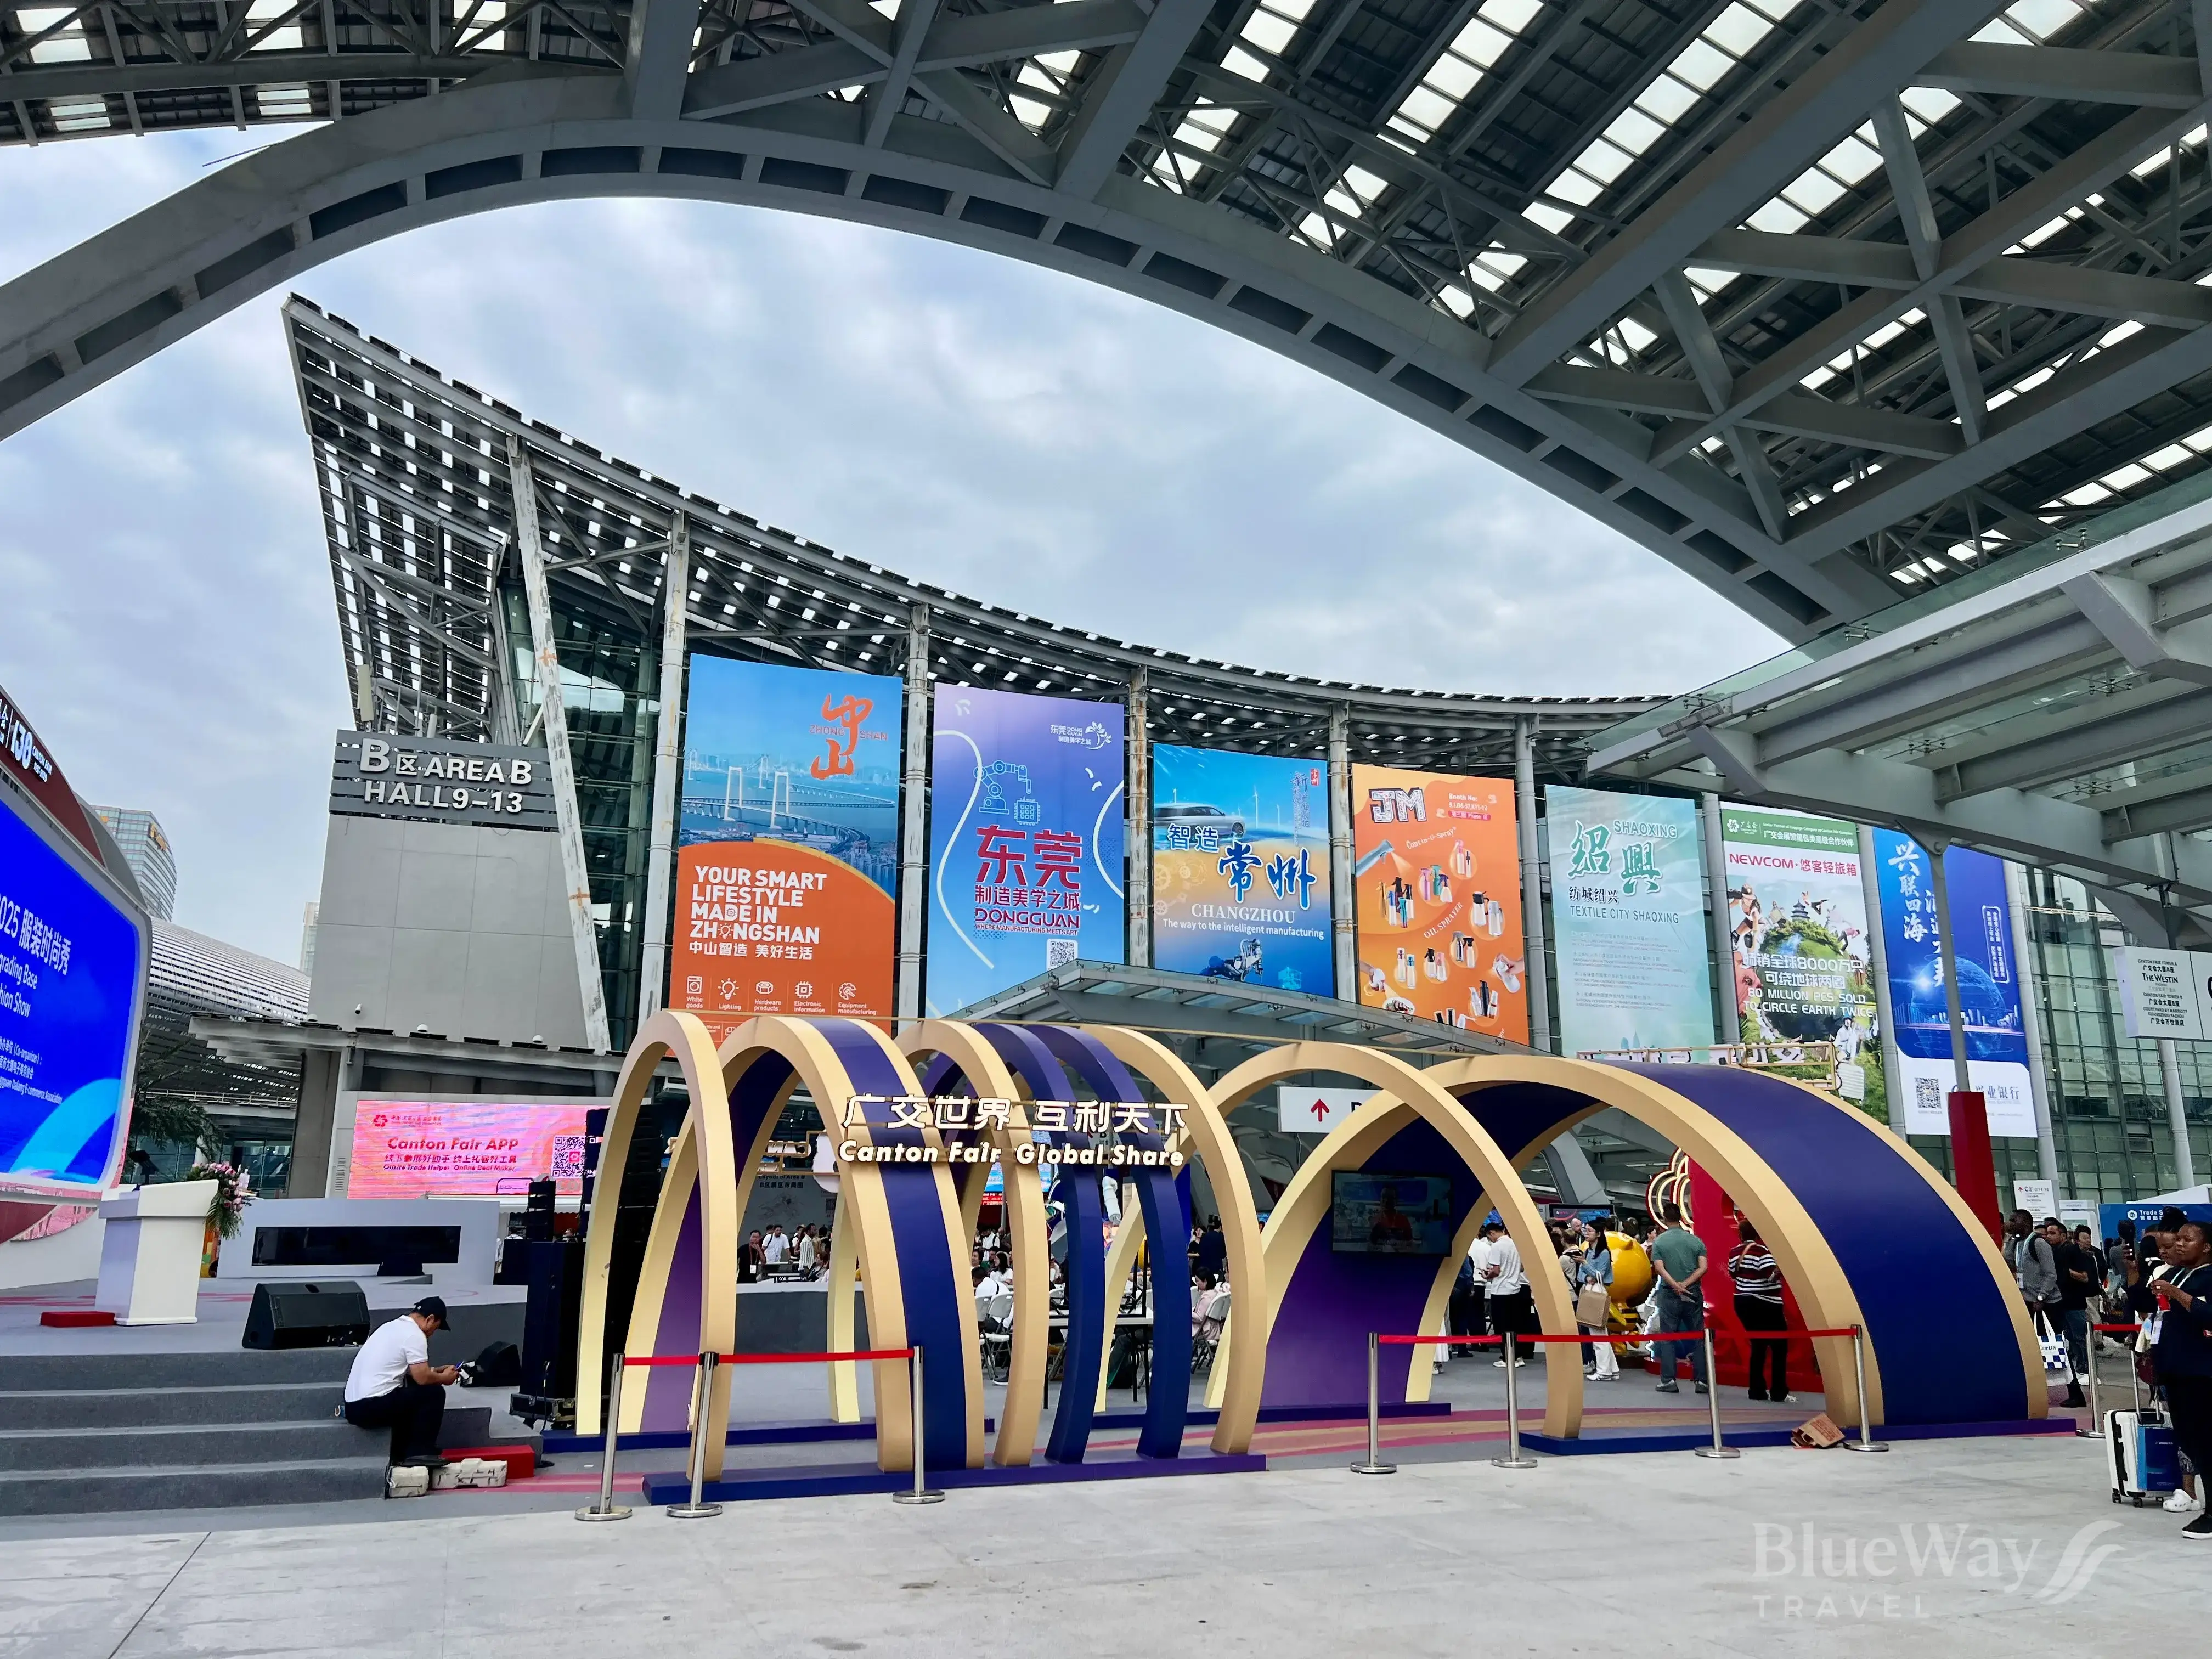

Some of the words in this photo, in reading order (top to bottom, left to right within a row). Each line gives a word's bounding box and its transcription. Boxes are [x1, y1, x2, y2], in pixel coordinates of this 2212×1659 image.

[809, 724, 845, 736] ZHONG
[860, 729, 888, 741] SHAN
[1167, 823, 1220, 853] 智造
[1613, 820, 1678, 838] SHAOXING
[975, 825, 1082, 889] 东莞
[695, 865, 751, 886] YOUR
[755, 870, 827, 890] SMART
[1217, 840, 1317, 910] 常州
[692, 884, 804, 907] LIFESTYLE
[975, 885, 1080, 911] 制造美学之城
[1569, 886, 1619, 904] 纺城绍兴
[1888, 841, 1928, 943] 兴联四海
[691, 902, 752, 922] MADE
[756, 906, 777, 924] IN
[975, 908, 1079, 928] DONGGUAN
[1192, 904, 1295, 923] CHANGZHOU
[1424, 926, 1438, 938] OIL
[1437, 901, 1463, 930] SPRAYER
[1570, 905, 1606, 918] TEXTILE
[1610, 909, 1629, 920] CITY
[1633, 910, 1679, 924] SHAOXING
[0, 893, 20, 939] 025
[19, 908, 71, 975] 服装时尚秀
[1163, 918, 1178, 928] The
[1180, 921, 1196, 930] way
[1198, 922, 1207, 930] to
[1209, 922, 1222, 931] the
[1223, 923, 1265, 935] intelligent
[1266, 927, 1324, 940] manufacturing
[689, 941, 747, 957] 中山智造
[755, 944, 813, 960] 美好生活
[1743, 952, 1864, 973] 畅销全球8000万只
[23, 963, 38, 989] Base
[1764, 970, 1845, 989] 可绕地球两圈
[13, 991, 31, 1018] Show
[1748, 988, 1763, 997] 80
[1768, 989, 1809, 1001] MILLION
[1814, 992, 1833, 1002] PCS
[1838, 994, 1866, 1003] SOLD
[1743, 1001, 1757, 1011] TO
[1762, 1002, 1797, 1013] CIRCLE
[1802, 1006, 1836, 1015] EARTH
[1840, 1006, 1873, 1017] TWICE
[842, 1093, 1012, 1132] 广交世界
[1032, 1099, 1189, 1135] 互利天下
[388, 1137, 445, 1150] Canton
[451, 1138, 482, 1150] Fair
[485, 1138, 518, 1151] APP
[839, 1141, 939, 1163] Canton
[949, 1142, 1003, 1164] Fair
[1016, 1143, 1104, 1165] Global
[1111, 1144, 1184, 1167] Share
